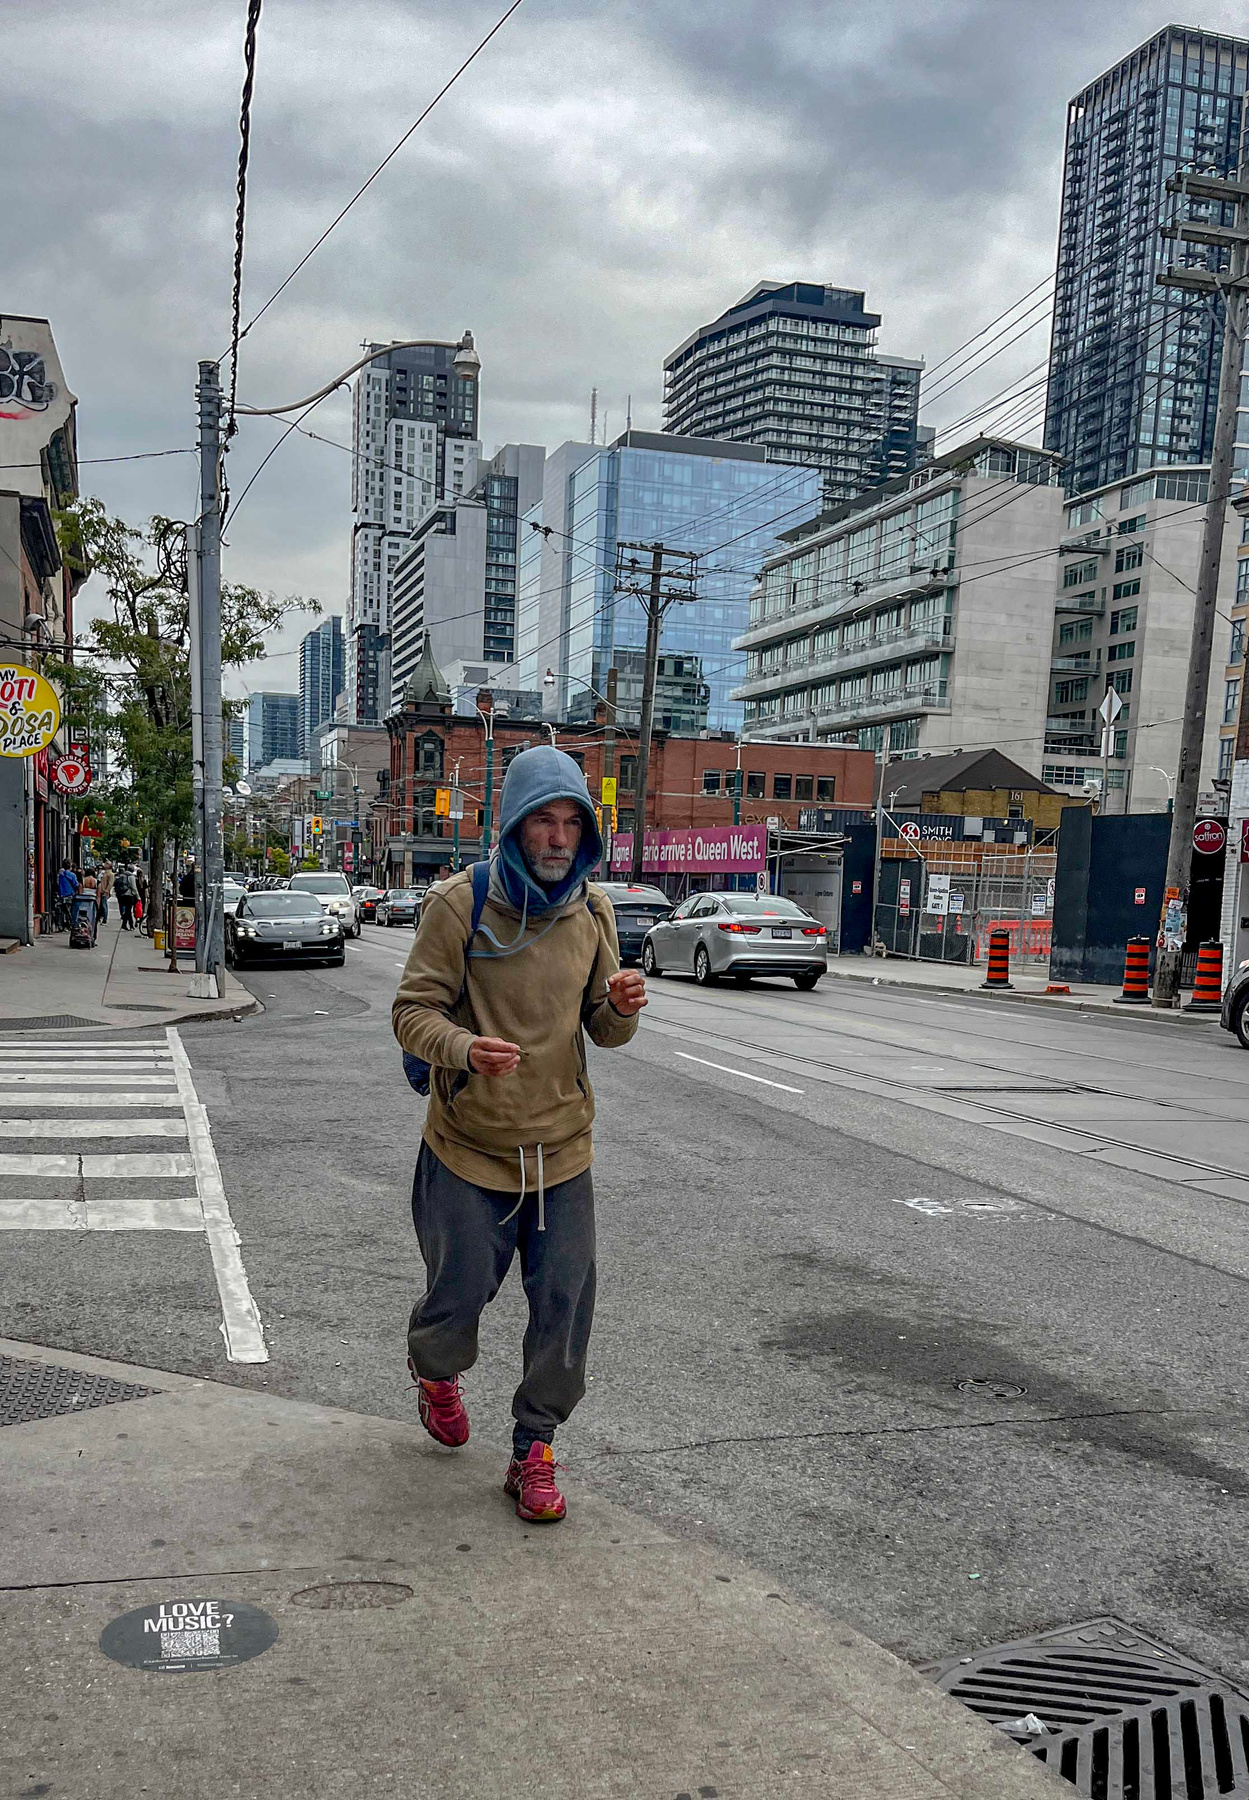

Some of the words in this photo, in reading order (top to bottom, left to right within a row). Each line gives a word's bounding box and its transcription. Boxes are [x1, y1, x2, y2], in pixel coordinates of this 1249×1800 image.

[0, 679, 35, 702] OTI
[9, 701, 23, 716] &
[3, 733, 41, 751] PLACE
[53, 755, 90, 771] LOUISIANA
[54, 780, 88, 793] KITCHEN
[1010, 791, 1023, 801] 161
[922, 825, 953, 836] SMITH
[1194, 831, 1223, 842] saffron
[612, 840, 629, 868] ligne
[660, 837, 686, 861] arrive
[687, 836, 692, 861] à
[694, 836, 728, 861] Queen
[730, 834, 761, 861] West.
[159, 1601, 219, 1618] LOVE
